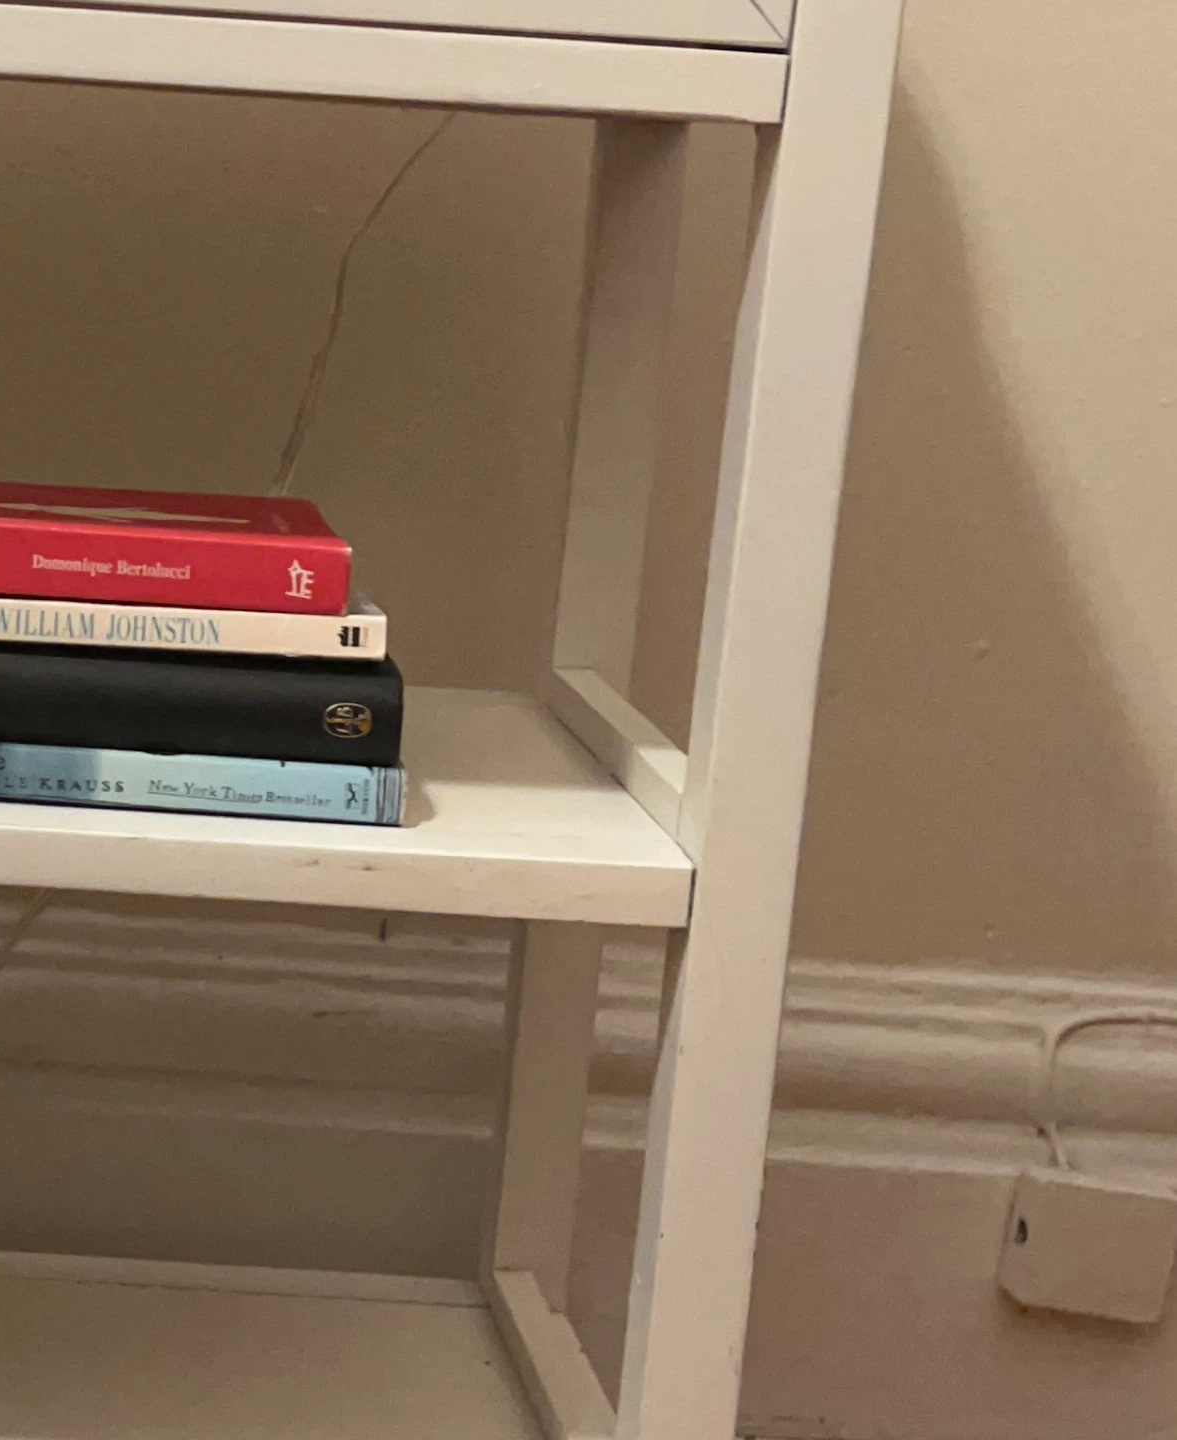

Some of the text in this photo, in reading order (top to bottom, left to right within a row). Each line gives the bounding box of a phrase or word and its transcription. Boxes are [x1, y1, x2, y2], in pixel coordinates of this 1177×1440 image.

[117, 559, 191, 580] Bertolucci
[106, 613, 220, 645] JOHNSTON
[39, 777, 124, 793] KRAUSS
[148, 779, 178, 793] New
[184, 781, 218, 798] York
